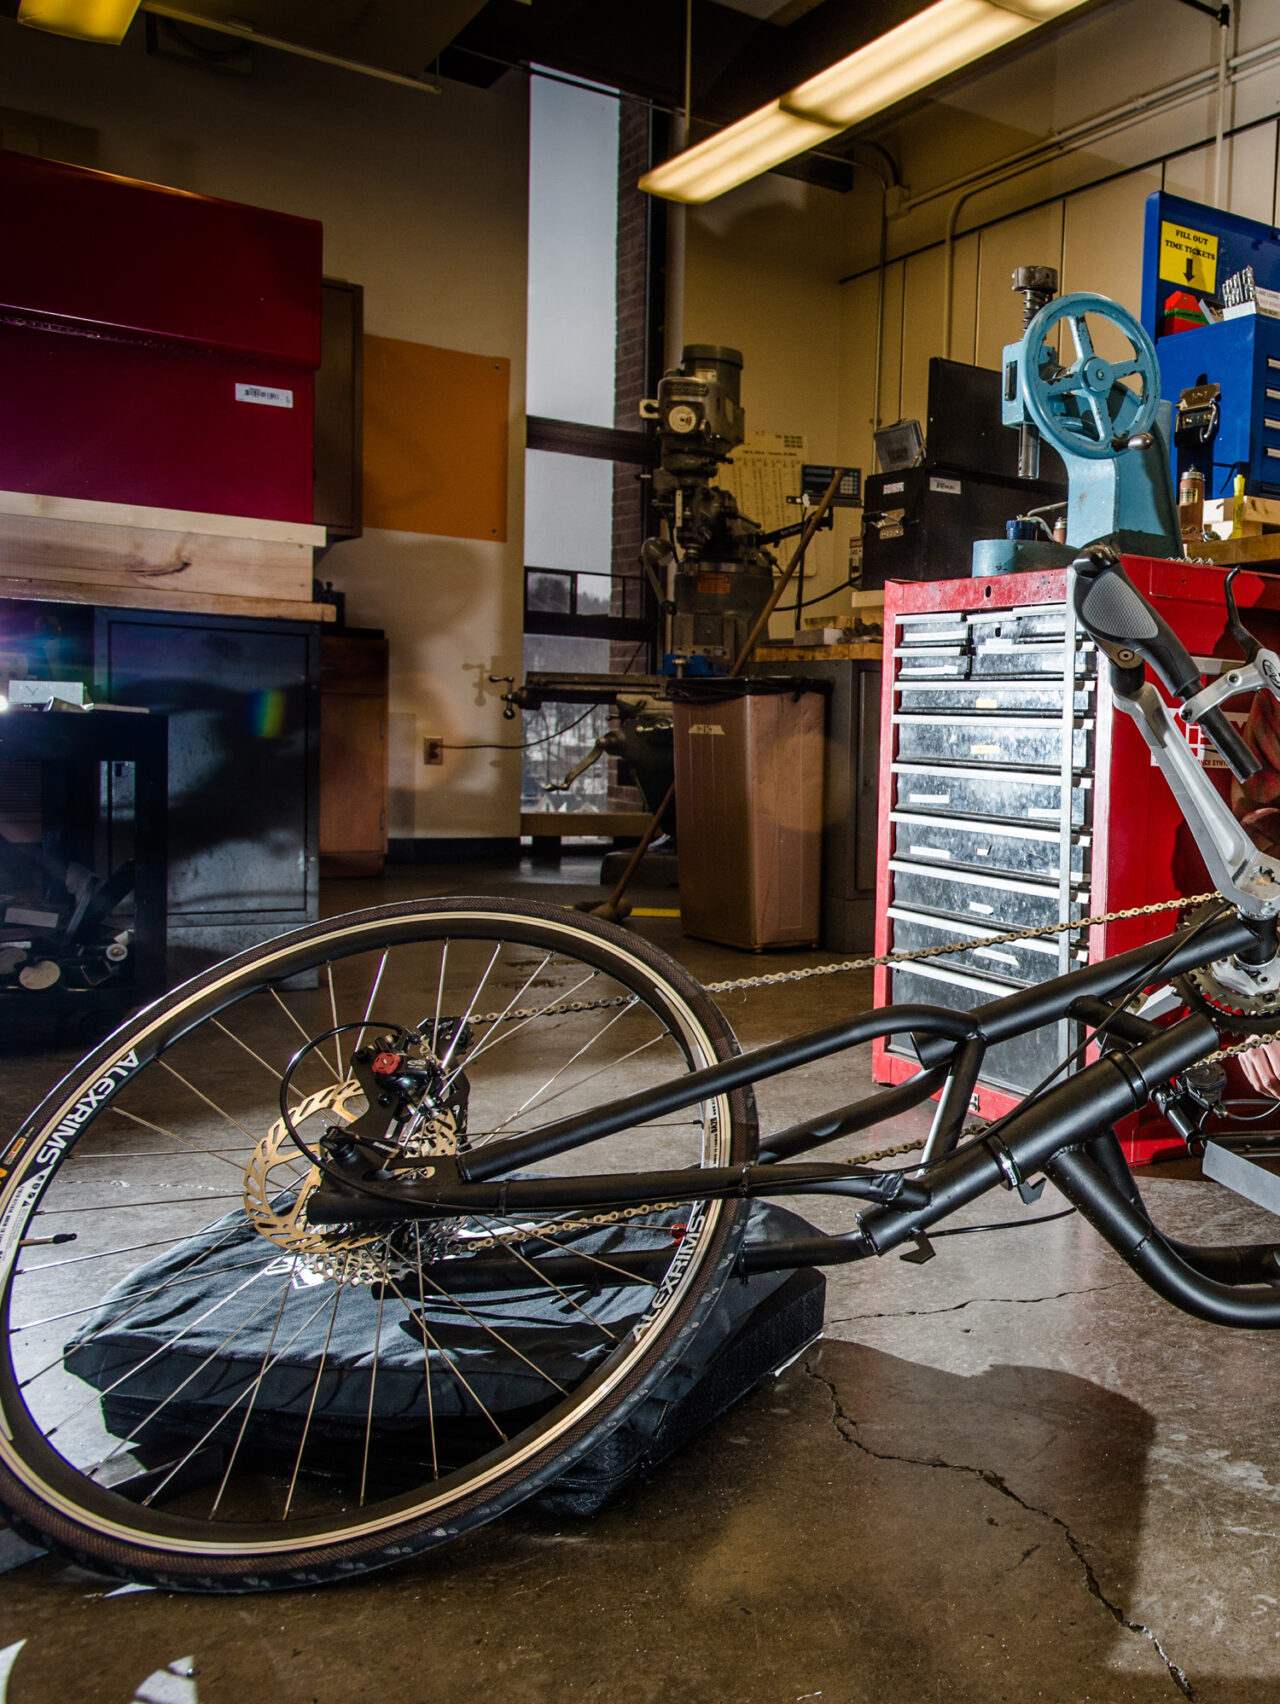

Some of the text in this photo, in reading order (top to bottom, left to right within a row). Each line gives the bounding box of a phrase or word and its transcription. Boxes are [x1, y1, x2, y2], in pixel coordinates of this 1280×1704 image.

[1165, 239, 1216, 261] TIME TICKETS
[1175, 230, 1209, 246] FILL OUT
[35, 1048, 140, 1166] ALEXRIMS
[632, 1213, 706, 1344] ALEXRIMS
